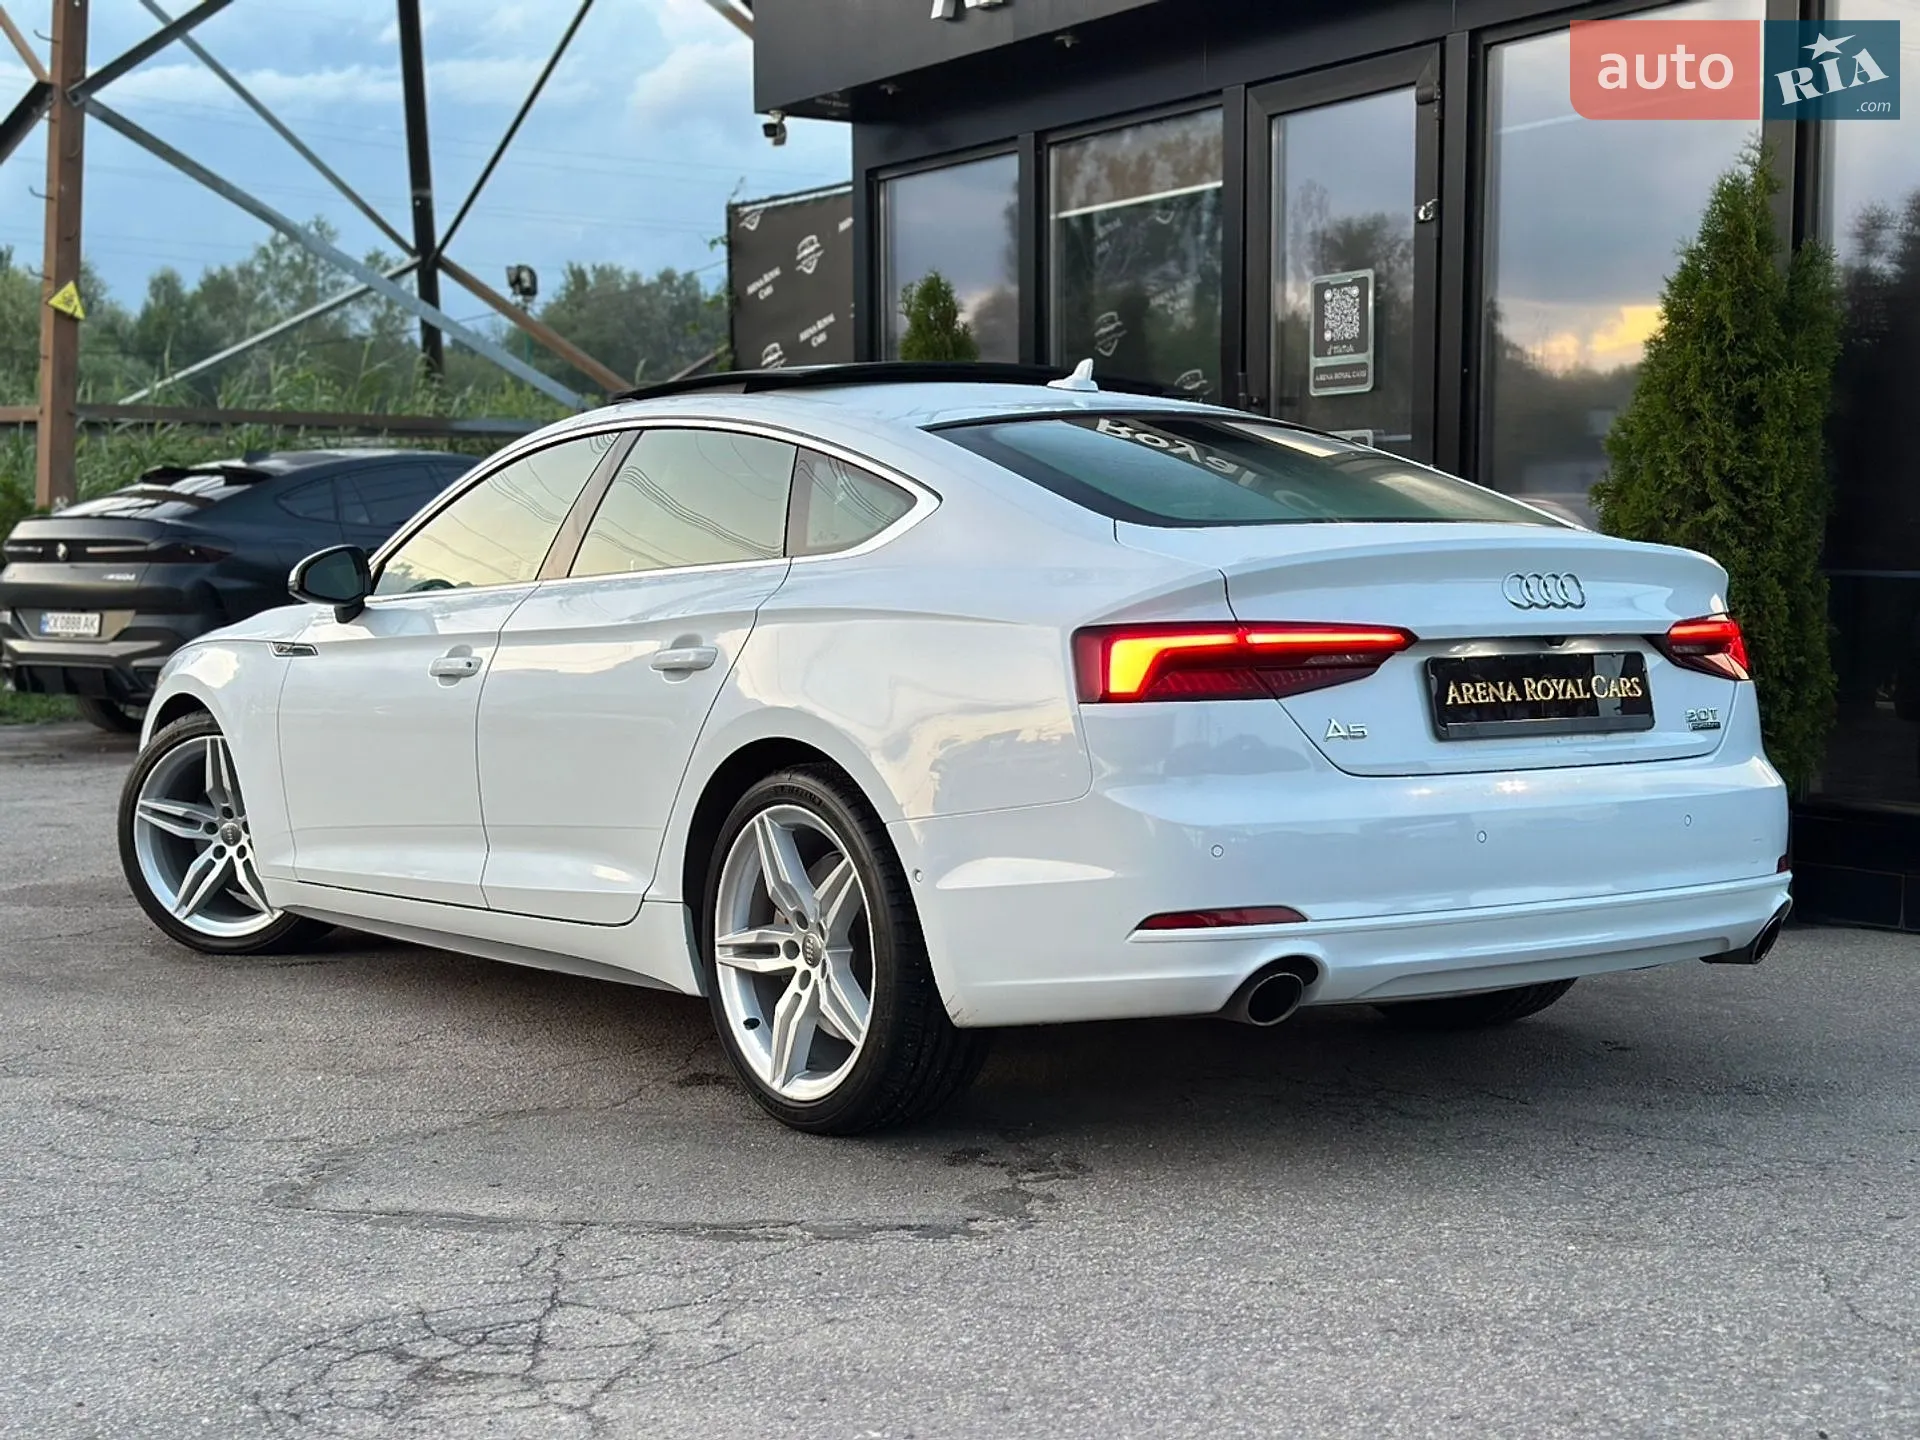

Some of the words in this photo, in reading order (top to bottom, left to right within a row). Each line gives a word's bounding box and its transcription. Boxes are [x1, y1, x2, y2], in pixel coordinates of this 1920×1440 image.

[1446, 680, 1522, 706] ARENA
[1522, 677, 1591, 701] ROYAL
[1591, 674, 1643, 698] CARS
[1323, 717, 1368, 742] A5
